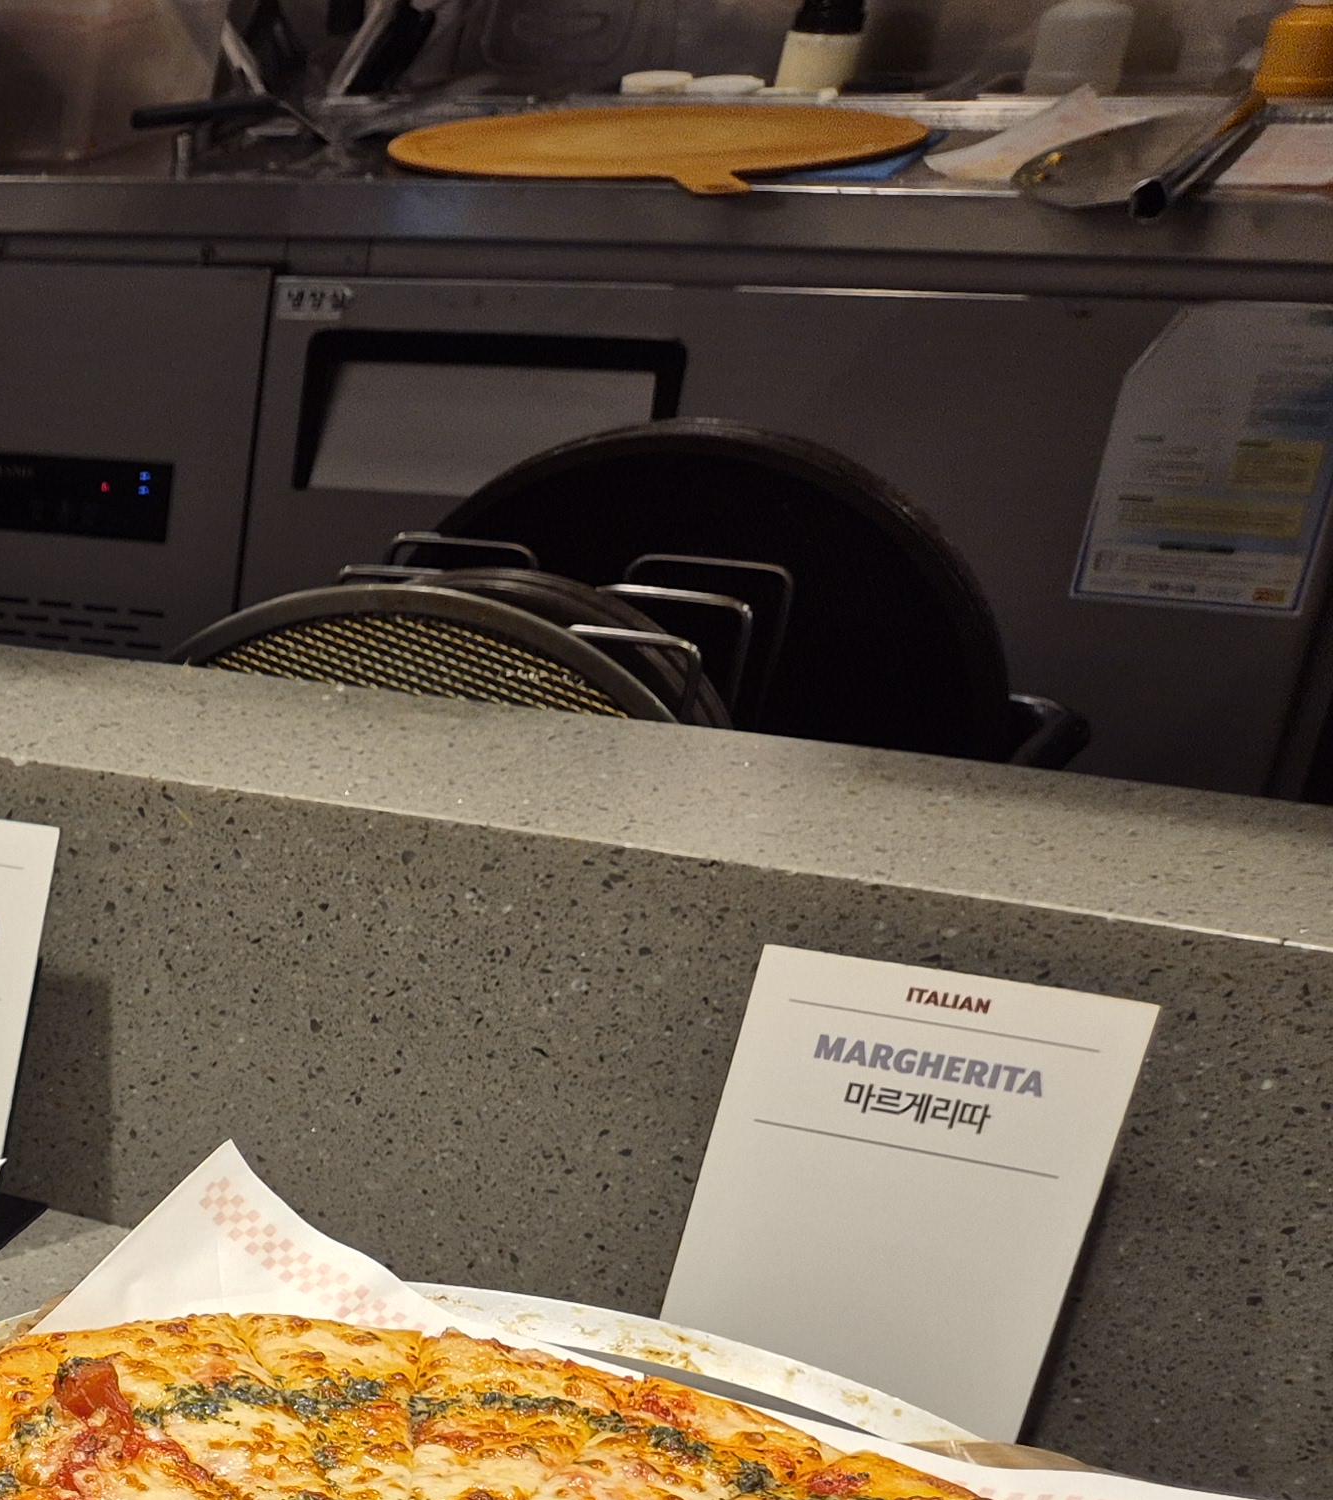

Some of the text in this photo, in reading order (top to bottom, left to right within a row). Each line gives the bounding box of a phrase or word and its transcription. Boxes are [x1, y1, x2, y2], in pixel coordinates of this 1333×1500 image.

[906, 987, 991, 1014] ITALIAN
[813, 1034, 1043, 1097] MARGHERITA
[844, 1082, 991, 1135] 마르게리따
